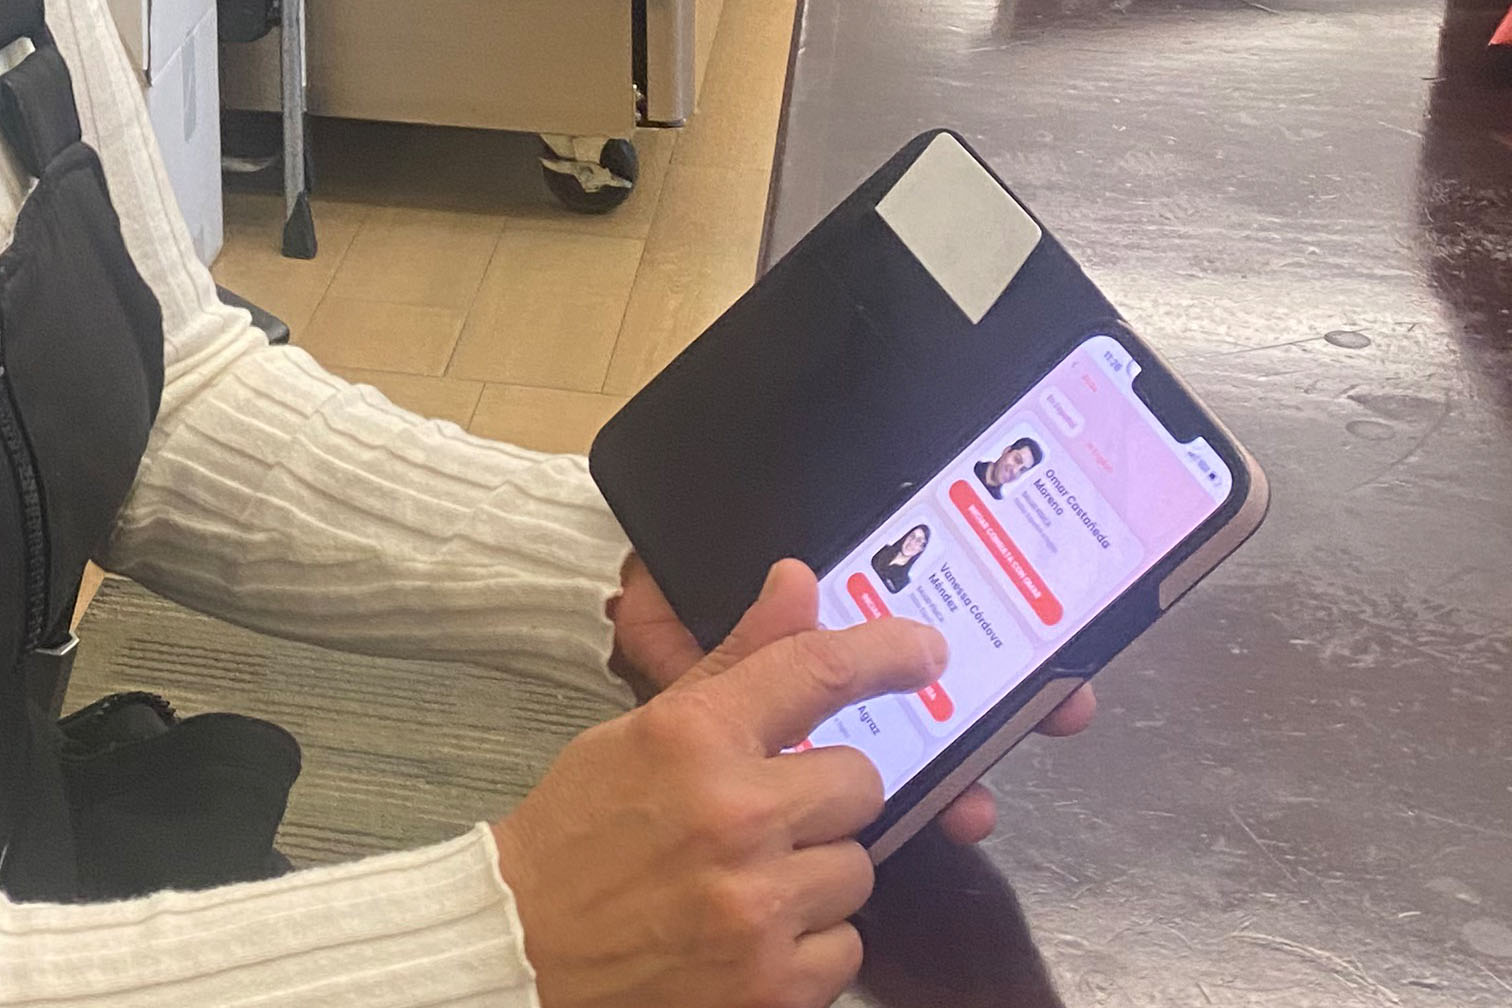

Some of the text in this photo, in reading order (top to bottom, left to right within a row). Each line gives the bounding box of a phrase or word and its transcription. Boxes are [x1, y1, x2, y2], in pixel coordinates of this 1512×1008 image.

[1032, 477, 1065, 516] Moreno
[1044, 467, 1112, 549] Omar Castañeda
[926, 572, 960, 612] Méndez
[937, 562, 1006, 649] Vanessa Córdova
[854, 703, 883, 737] Agraz
